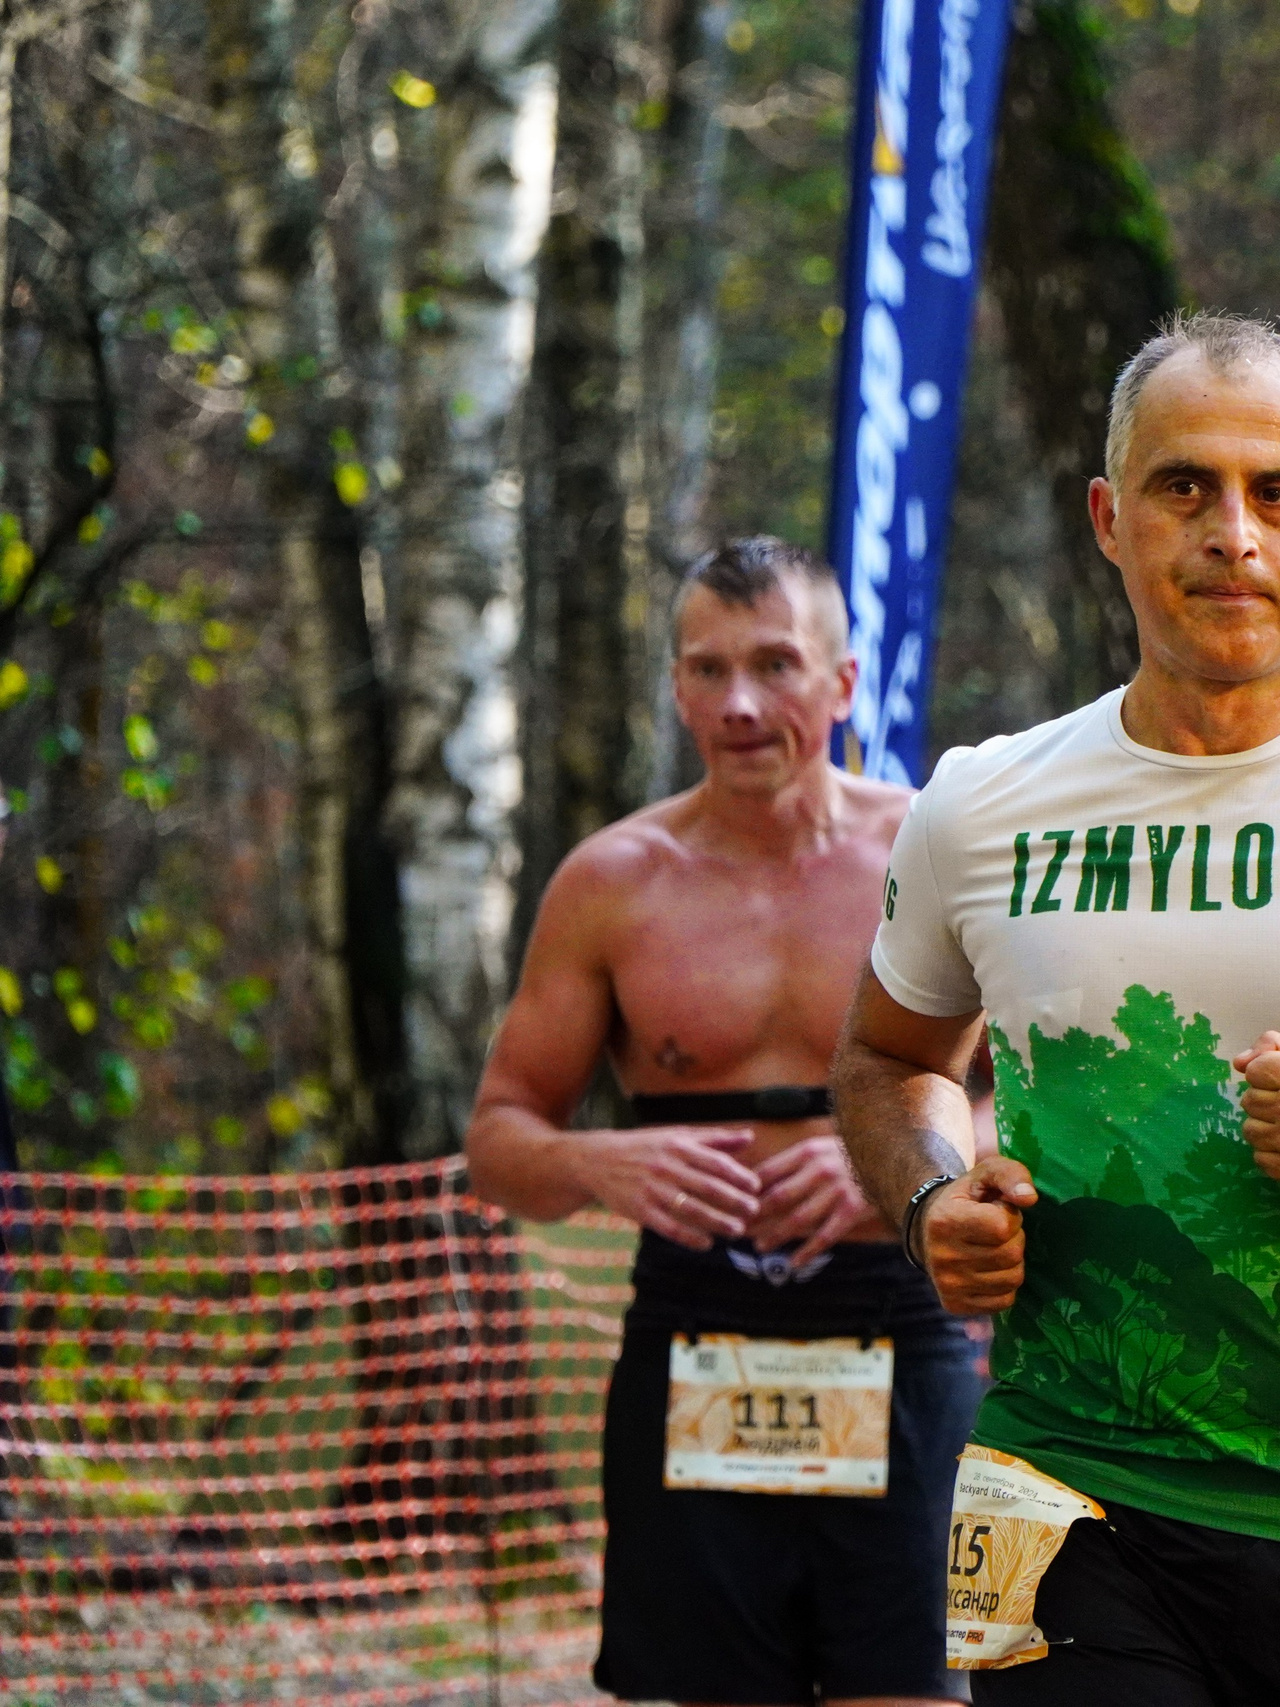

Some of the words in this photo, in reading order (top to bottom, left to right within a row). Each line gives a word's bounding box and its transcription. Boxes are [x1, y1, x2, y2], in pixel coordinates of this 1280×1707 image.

[734, 1393, 820, 1429] 111
[960, 1483, 989, 1497] Backyard
[982, 1475, 1015, 1489] сентября
[1018, 1485, 1038, 1499] 2024
[950, 1523, 992, 1577] 15
[966, 1631, 984, 1642] PRO
